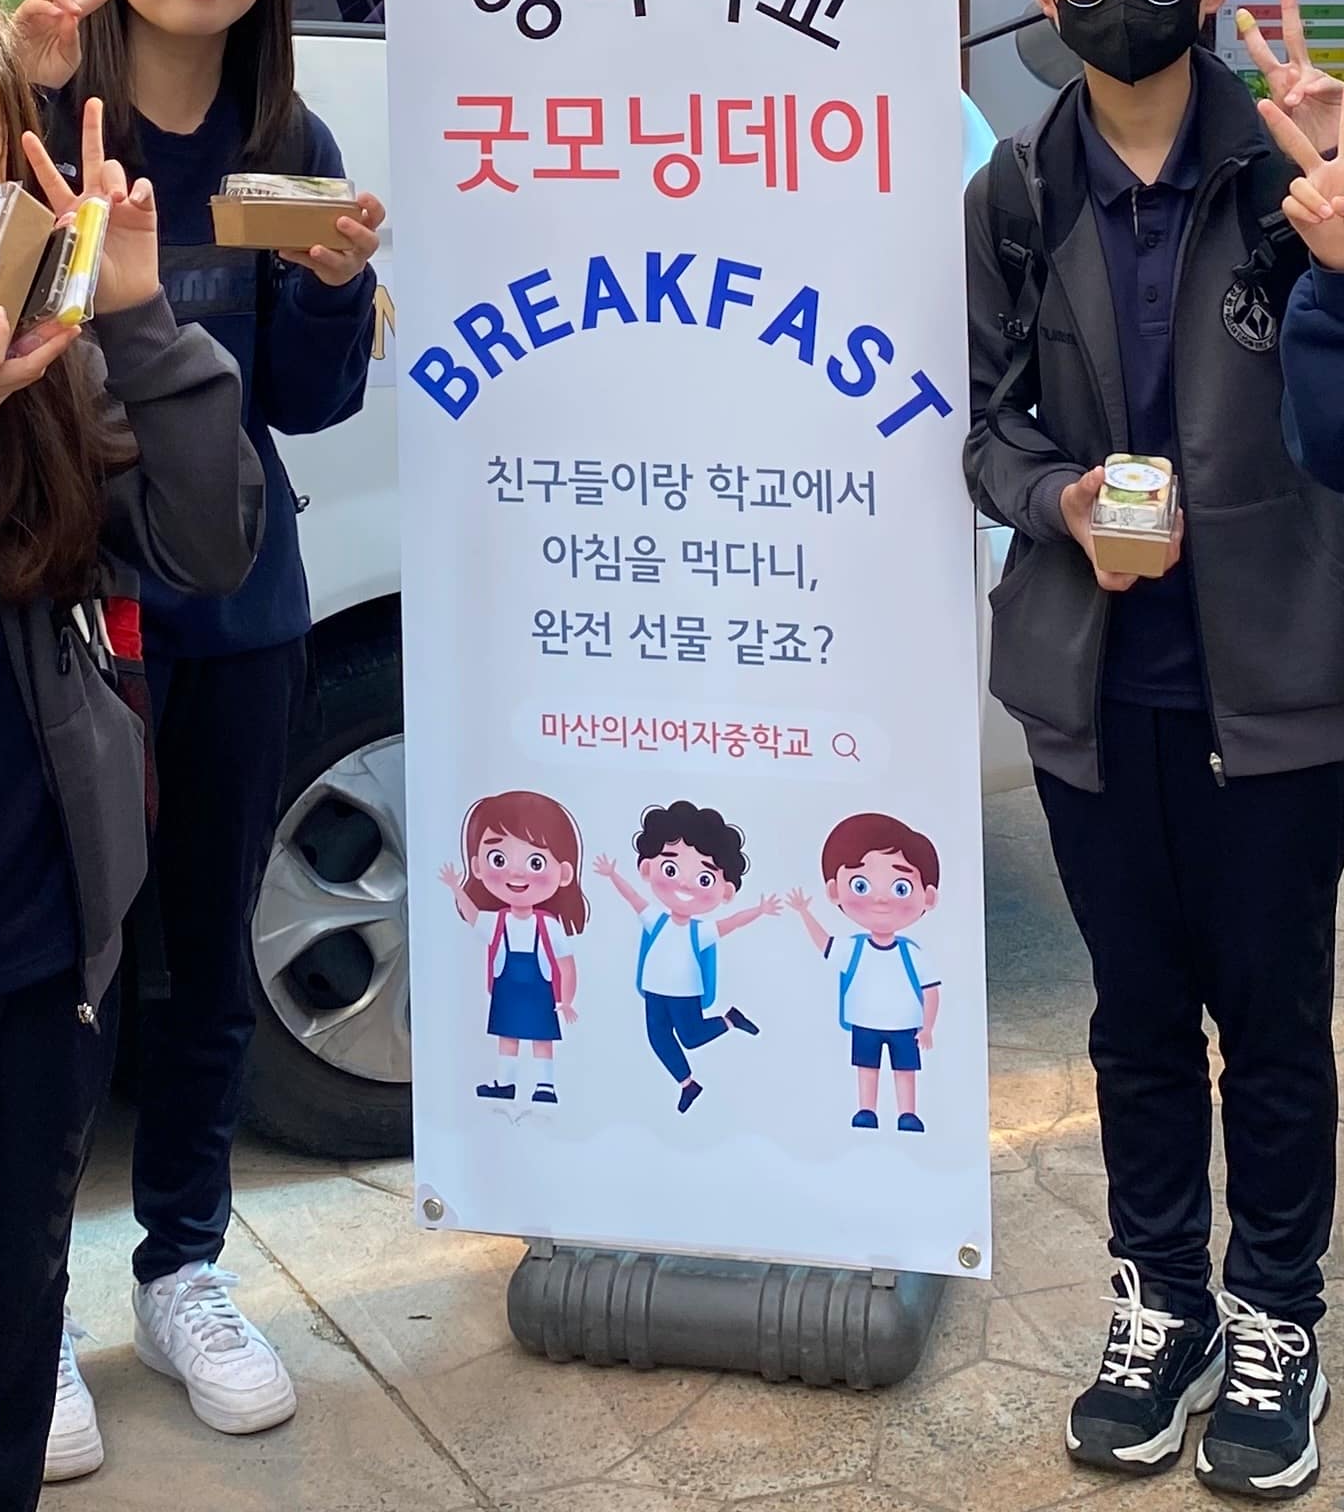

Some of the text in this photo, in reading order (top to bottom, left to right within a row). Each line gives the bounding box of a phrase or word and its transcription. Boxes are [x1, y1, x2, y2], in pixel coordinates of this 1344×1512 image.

[442, 94, 893, 199] 굿모닝데이
[408, 251, 953, 440] BREAKFAST
[485, 455, 878, 517] 친구들이랑 학교에서
[540, 534, 820, 592] 아침을 먹다니,
[530, 607, 835, 667] 완전 선물 같죠?
[540, 712, 813, 760] 마산의신여자중학교
